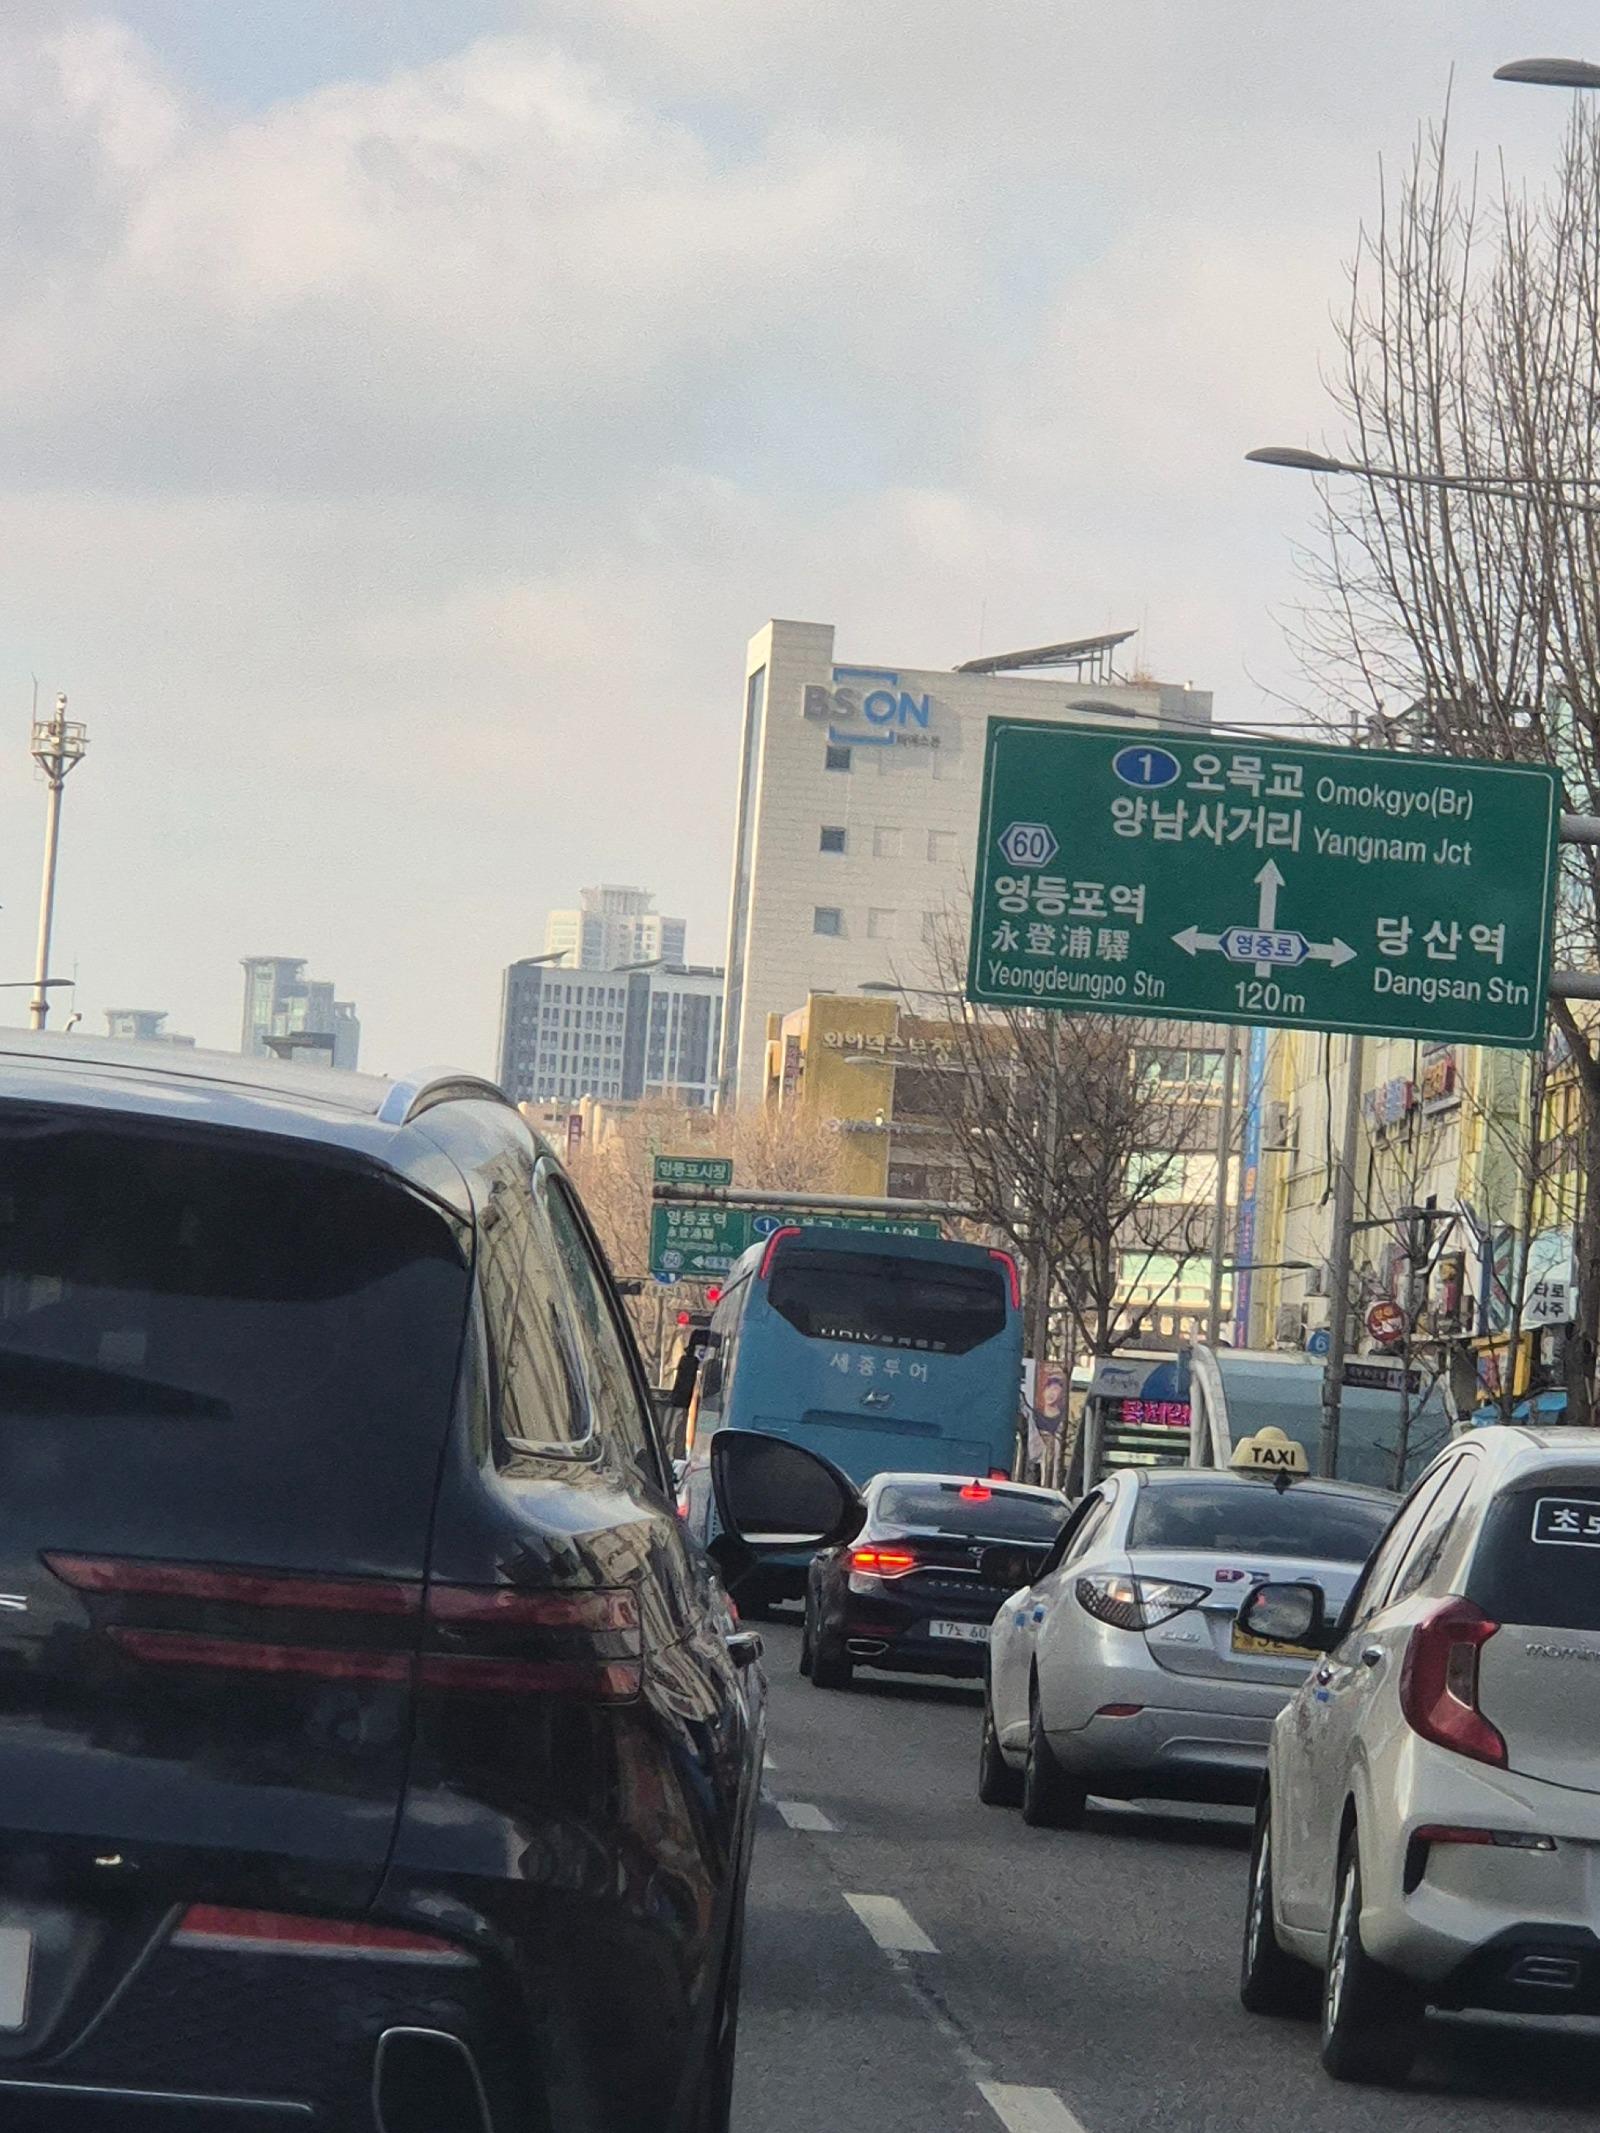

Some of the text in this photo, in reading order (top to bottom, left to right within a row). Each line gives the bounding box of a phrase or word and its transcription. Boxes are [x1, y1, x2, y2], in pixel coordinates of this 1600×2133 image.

[1138, 752, 1153, 782] 1
[1186, 753, 1305, 798] 오목교
[1316, 775, 1474, 821] Omokgyo(Br)
[1110, 795, 1302, 853] 양남사거리
[1013, 829, 1046, 859] 60
[1313, 825, 1474, 866] Yangnam Jct
[994, 874, 1147, 925] 영등포역
[990, 919, 1131, 962] 永登浦驛
[1235, 933, 1294, 958] 영중로
[1376, 914, 1506, 965] 당산역
[988, 958, 1166, 1000] Yeongdeungpo Stn
[1373, 966, 1530, 1006] Dangsan Stn
[1234, 980, 1306, 1014] 120m
[658, 1160, 729, 1180] 영등포시장
[666, 1210, 728, 1230] 영등포역
[1533, 1282, 1566, 1298] 타로
[1532, 1301, 1565, 1318] 사주
[829, 1352, 929, 1383] 세종투어
[1251, 1446, 1296, 1467] TAXI
